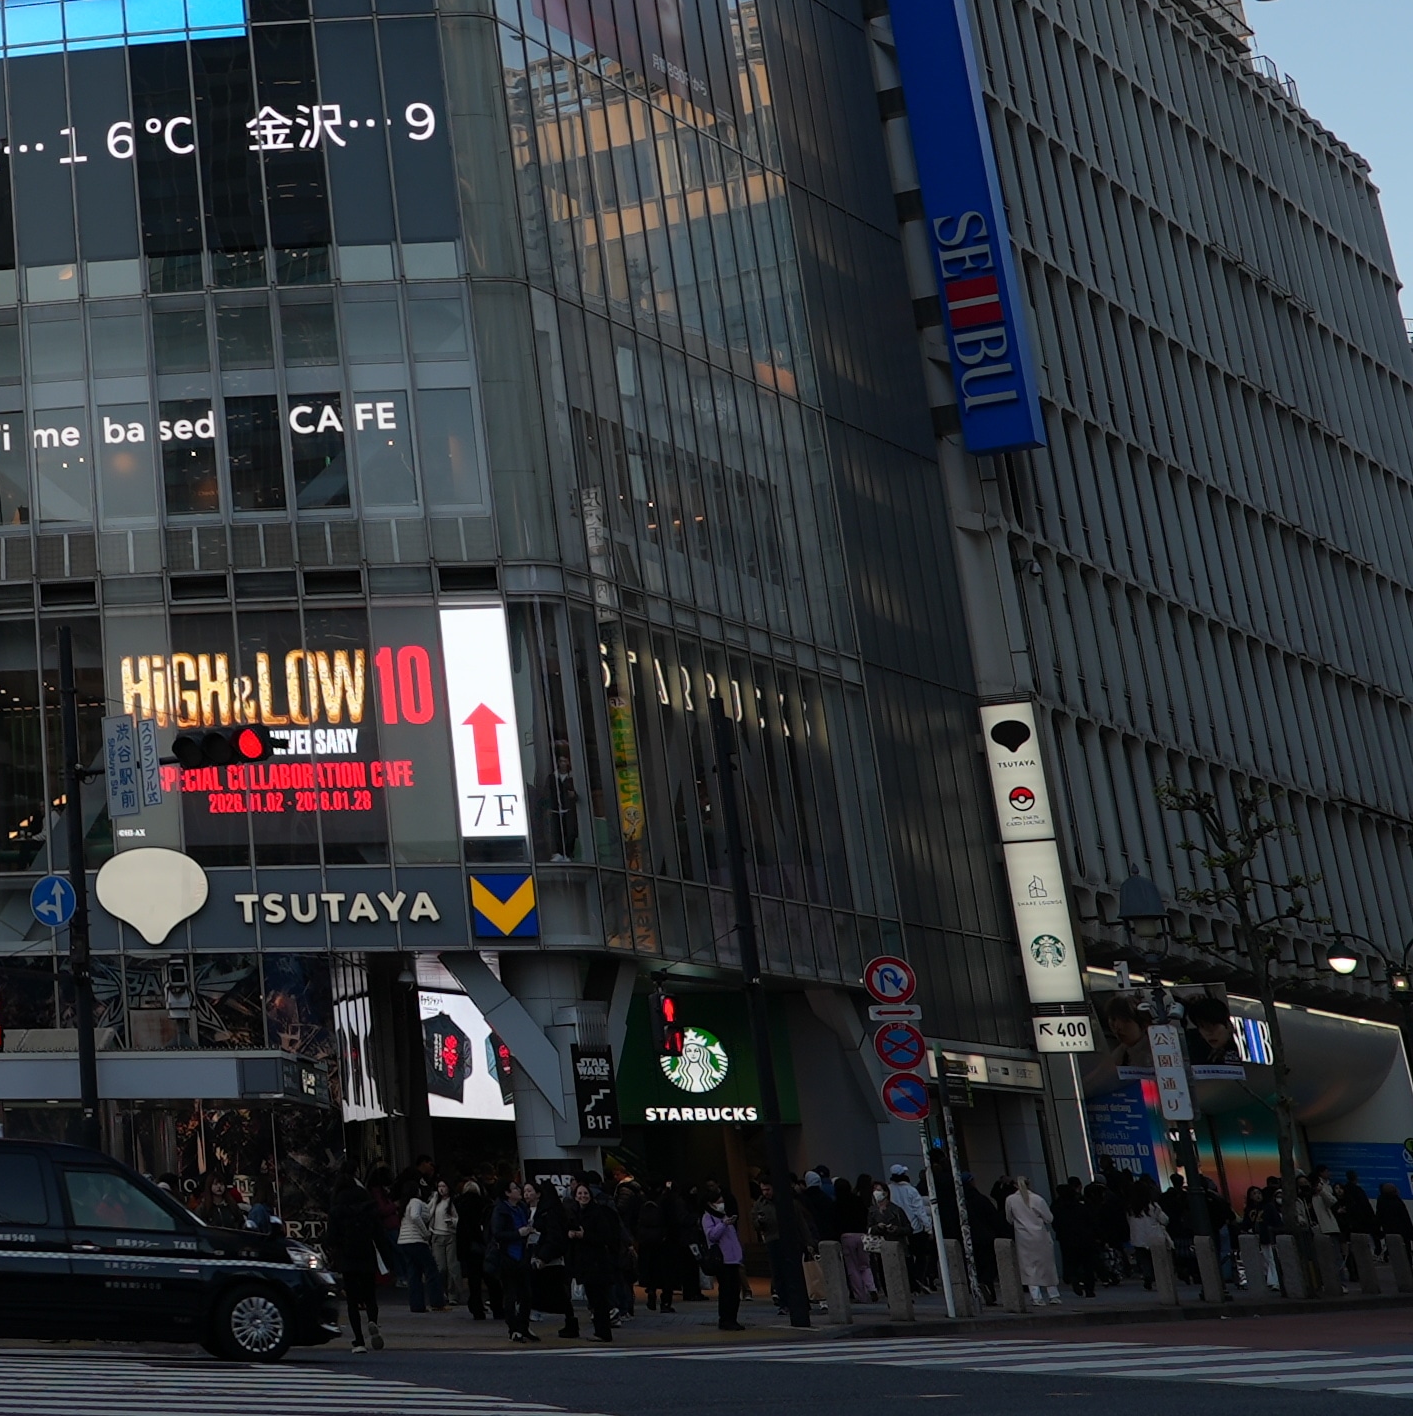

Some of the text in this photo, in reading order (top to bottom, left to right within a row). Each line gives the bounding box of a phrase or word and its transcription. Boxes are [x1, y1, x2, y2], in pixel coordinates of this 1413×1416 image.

[934, 210, 1020, 413] SEIBU
[104, 409, 216, 444] based
[289, 401, 395, 434] CAFE
[375, 645, 435, 725] 10
[107, 737, 117, 778] Shibuya
[115, 723, 136, 809] 渋谷駅前
[141, 721, 160, 805] スクランブル式
[370, 760, 415, 787] CAFE
[997, 760, 1036, 768] TSUTAYA
[467, 794, 518, 827] 7F
[234, 890, 442, 924] TSUTAYA
[1057, 1022, 1086, 1037] 400
[577, 1065, 610, 1077] WARS
[580, 1058, 607, 1068] STAR
[1153, 1032, 1179, 1112] 公園通り
[587, 1115, 613, 1130] B1F
[645, 1105, 758, 1123] STARBUCKS
